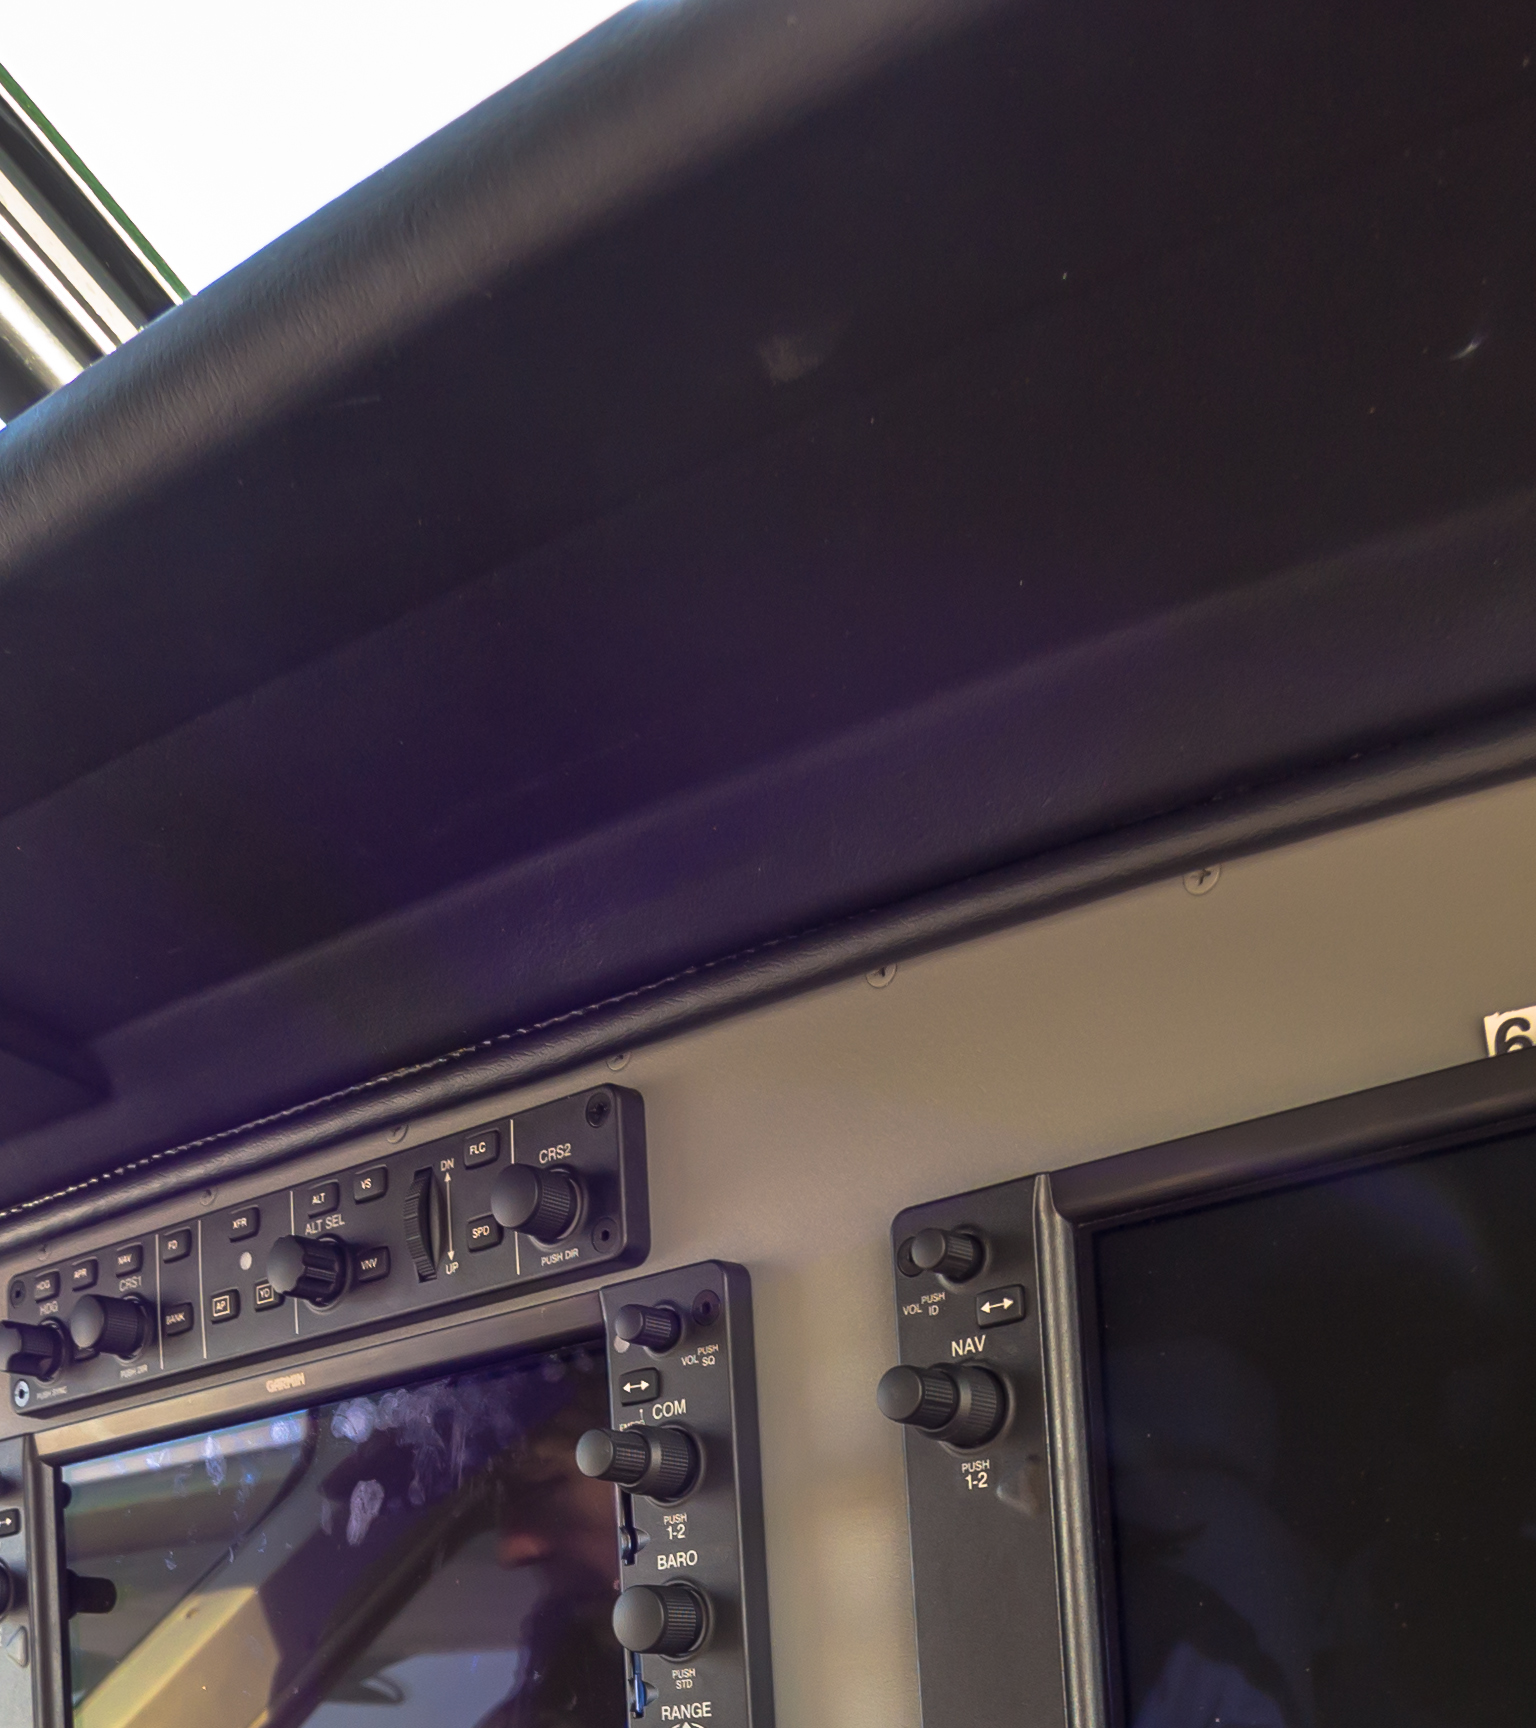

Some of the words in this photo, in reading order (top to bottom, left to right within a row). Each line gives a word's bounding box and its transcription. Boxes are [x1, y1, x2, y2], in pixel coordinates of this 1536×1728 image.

[538, 1143, 572, 1164] CRS2
[440, 1158, 455, 1172] DN
[305, 1219, 324, 1237] ALT
[324, 1213, 346, 1231] SEL
[471, 1225, 491, 1238] SPD
[540, 1252, 563, 1267] PUSH
[564, 1247, 580, 1261] DIR
[445, 1262, 460, 1276] UP
[920, 1291, 946, 1306] PUSH
[902, 1303, 922, 1316] VOL
[927, 1305, 940, 1317] ID
[697, 1344, 719, 1356] PUSH
[951, 1335, 987, 1357] NAV
[680, 1354, 699, 1366] VOL
[652, 1398, 687, 1420] COM
[961, 1459, 990, 1473] PUSH
[964, 1472, 989, 1489] 1-2
[664, 1513, 688, 1525] PUSH
[666, 1524, 686, 1540] 1-2
[657, 1550, 699, 1570] BARO
[672, 1668, 696, 1680] PUSH
[675, 1679, 693, 1690] STD
[661, 1701, 713, 1721] RANGE
